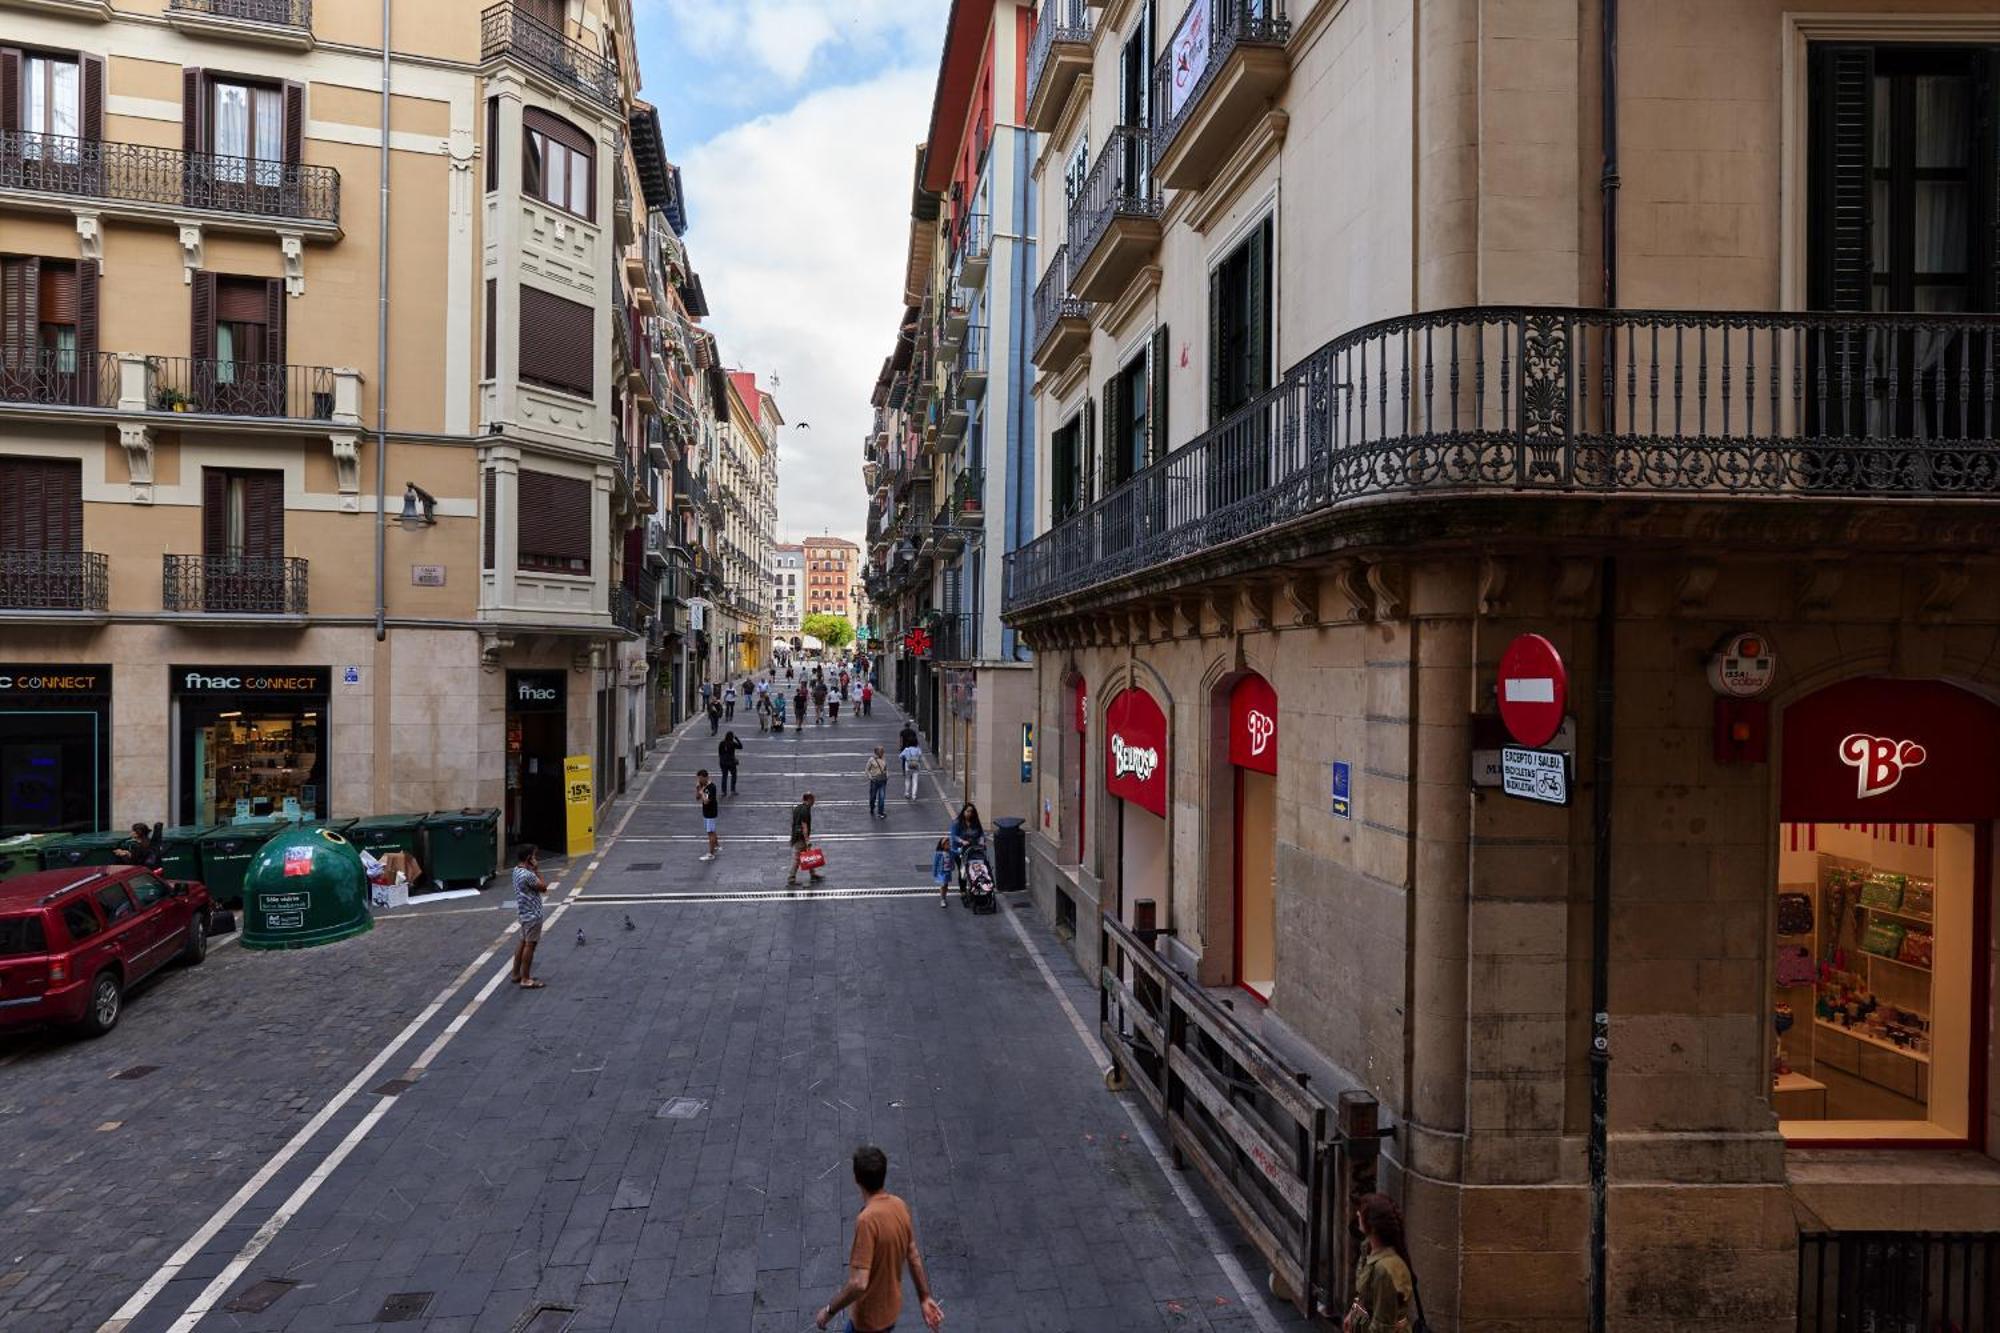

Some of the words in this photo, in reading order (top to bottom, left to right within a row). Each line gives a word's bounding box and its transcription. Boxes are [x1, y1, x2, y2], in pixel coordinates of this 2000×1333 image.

[185, 672, 241, 689] fnac
[245, 677, 316, 690] CONNECT
[519, 686, 556, 700] fnac
[1504, 751, 1533, 766] EXCEPTO
